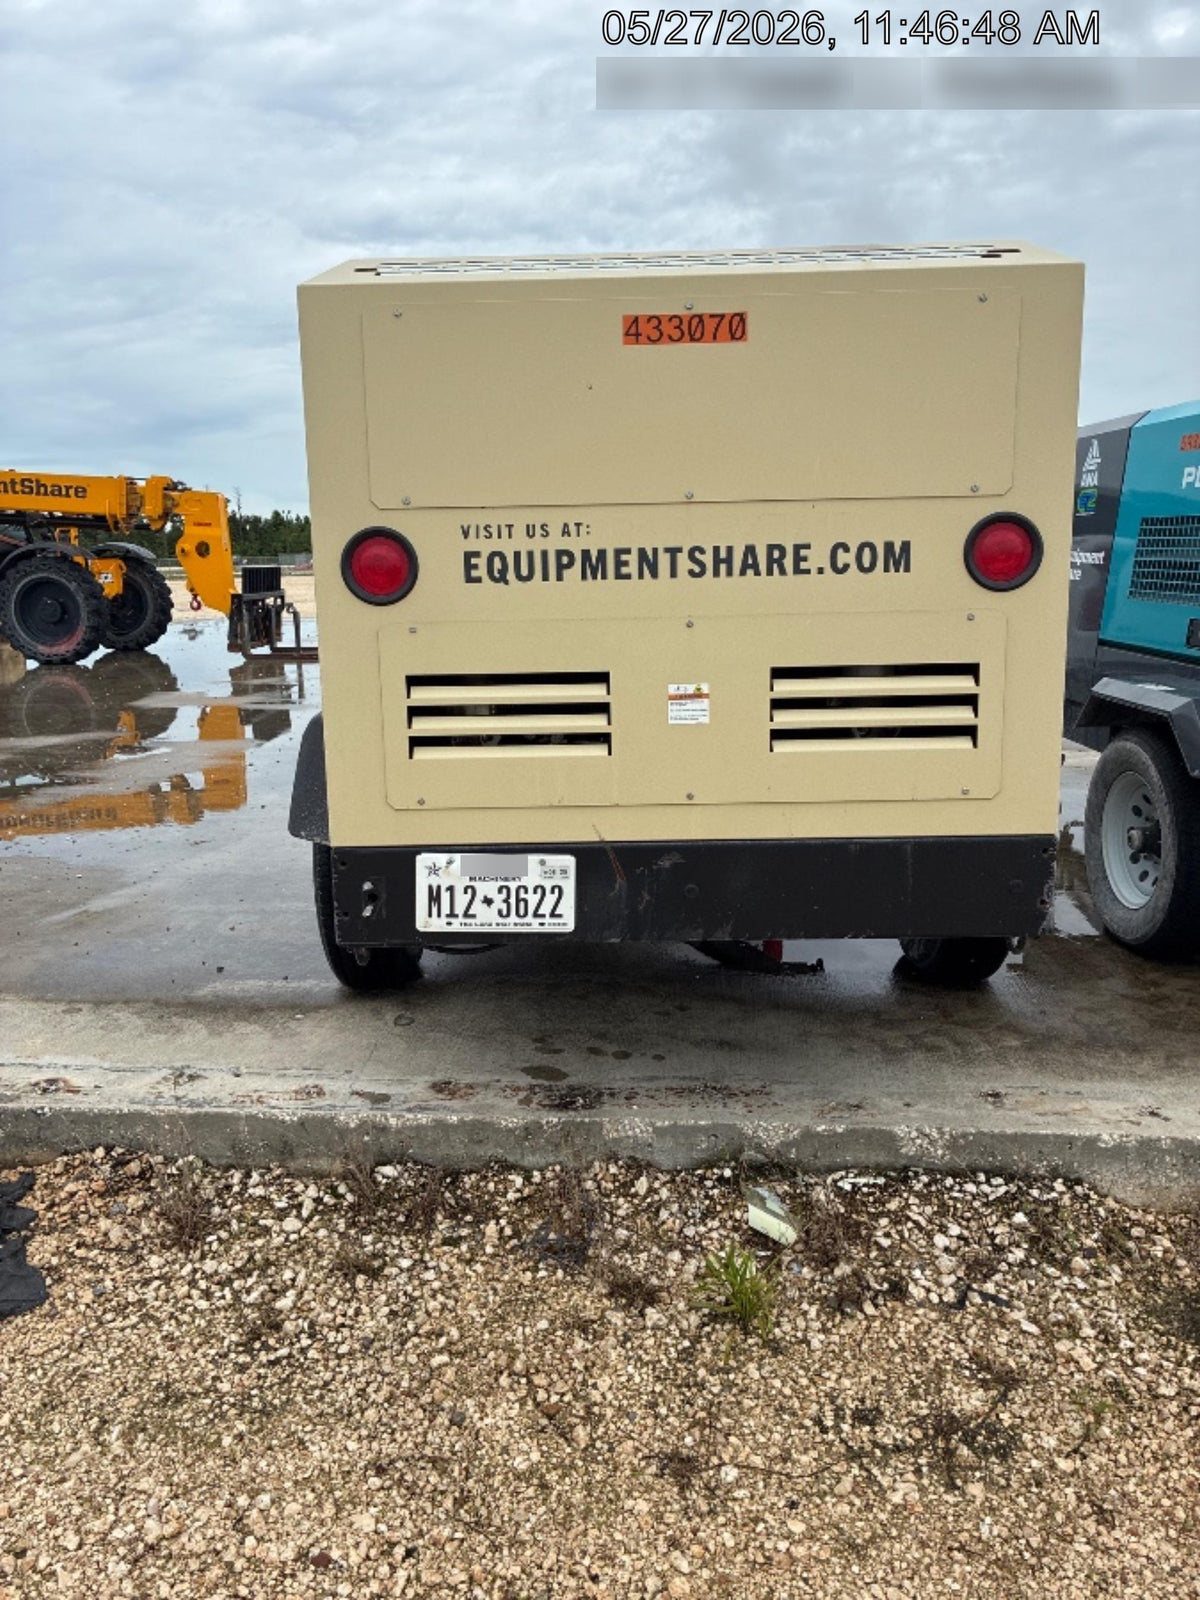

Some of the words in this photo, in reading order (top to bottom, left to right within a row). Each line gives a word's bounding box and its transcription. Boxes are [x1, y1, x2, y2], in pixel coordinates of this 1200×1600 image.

[624, 312, 746, 343] 433070
[460, 524, 515, 540] VISIT
[526, 523, 550, 539] US
[561, 522, 592, 538] AT:
[463, 540, 911, 585] EQUIPMENTSHARE.COM
